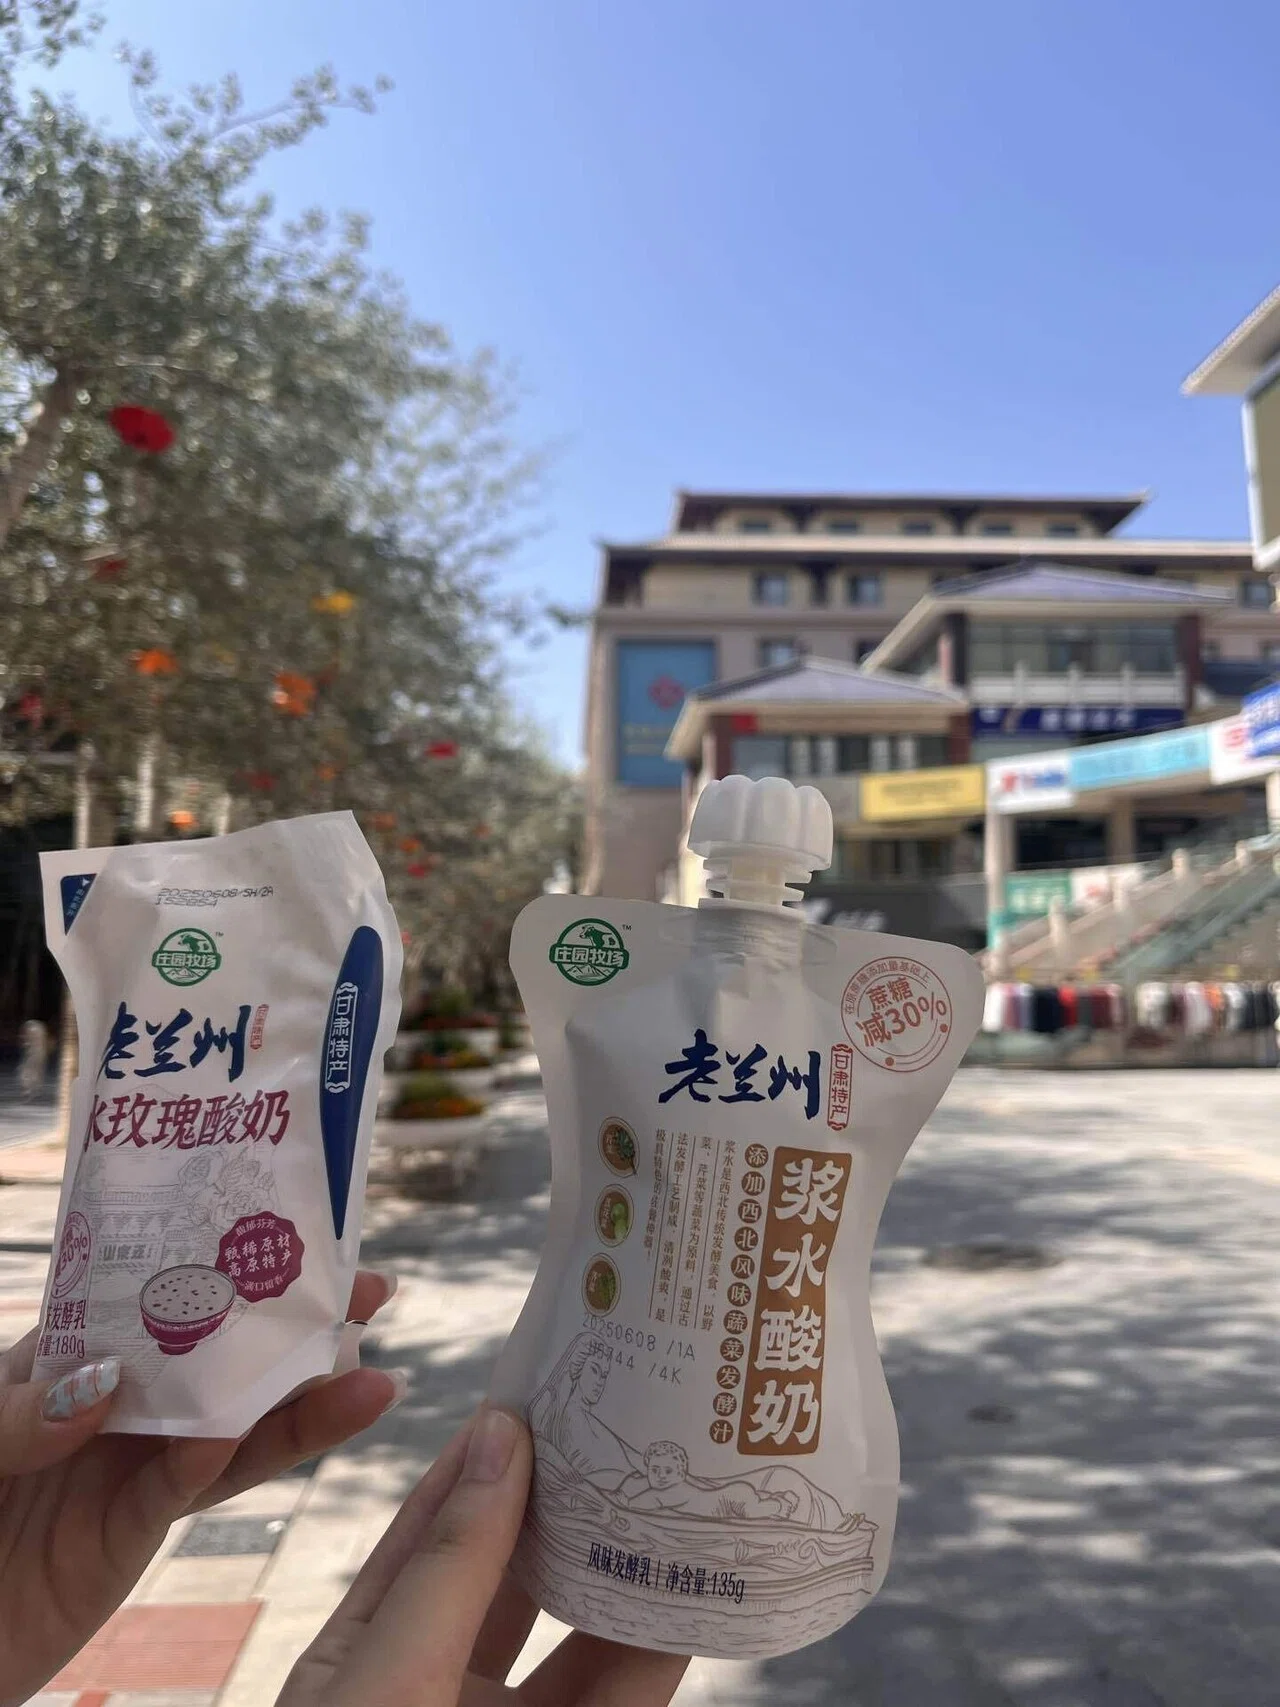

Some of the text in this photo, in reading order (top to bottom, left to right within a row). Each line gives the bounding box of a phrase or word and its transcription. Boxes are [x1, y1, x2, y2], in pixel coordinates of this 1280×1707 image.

[156, 952, 217, 969] 庄园牧场
[555, 946, 624, 968] 庄园牧场
[855, 991, 947, 1047] 减30%
[866, 976, 914, 1011] 蔗糖
[327, 994, 353, 1081] 甘肃特产
[658, 1028, 821, 1120] 老兰州
[830, 1053, 850, 1119] 甘肃特产
[229, 1248, 292, 1277] 高原特产
[711, 1144, 767, 1443] 添加西北风味蔬菜发酵汁
[746, 1158, 844, 1446] 浆水酸奶
[587, 1542, 651, 1586] 风味发酵乳
